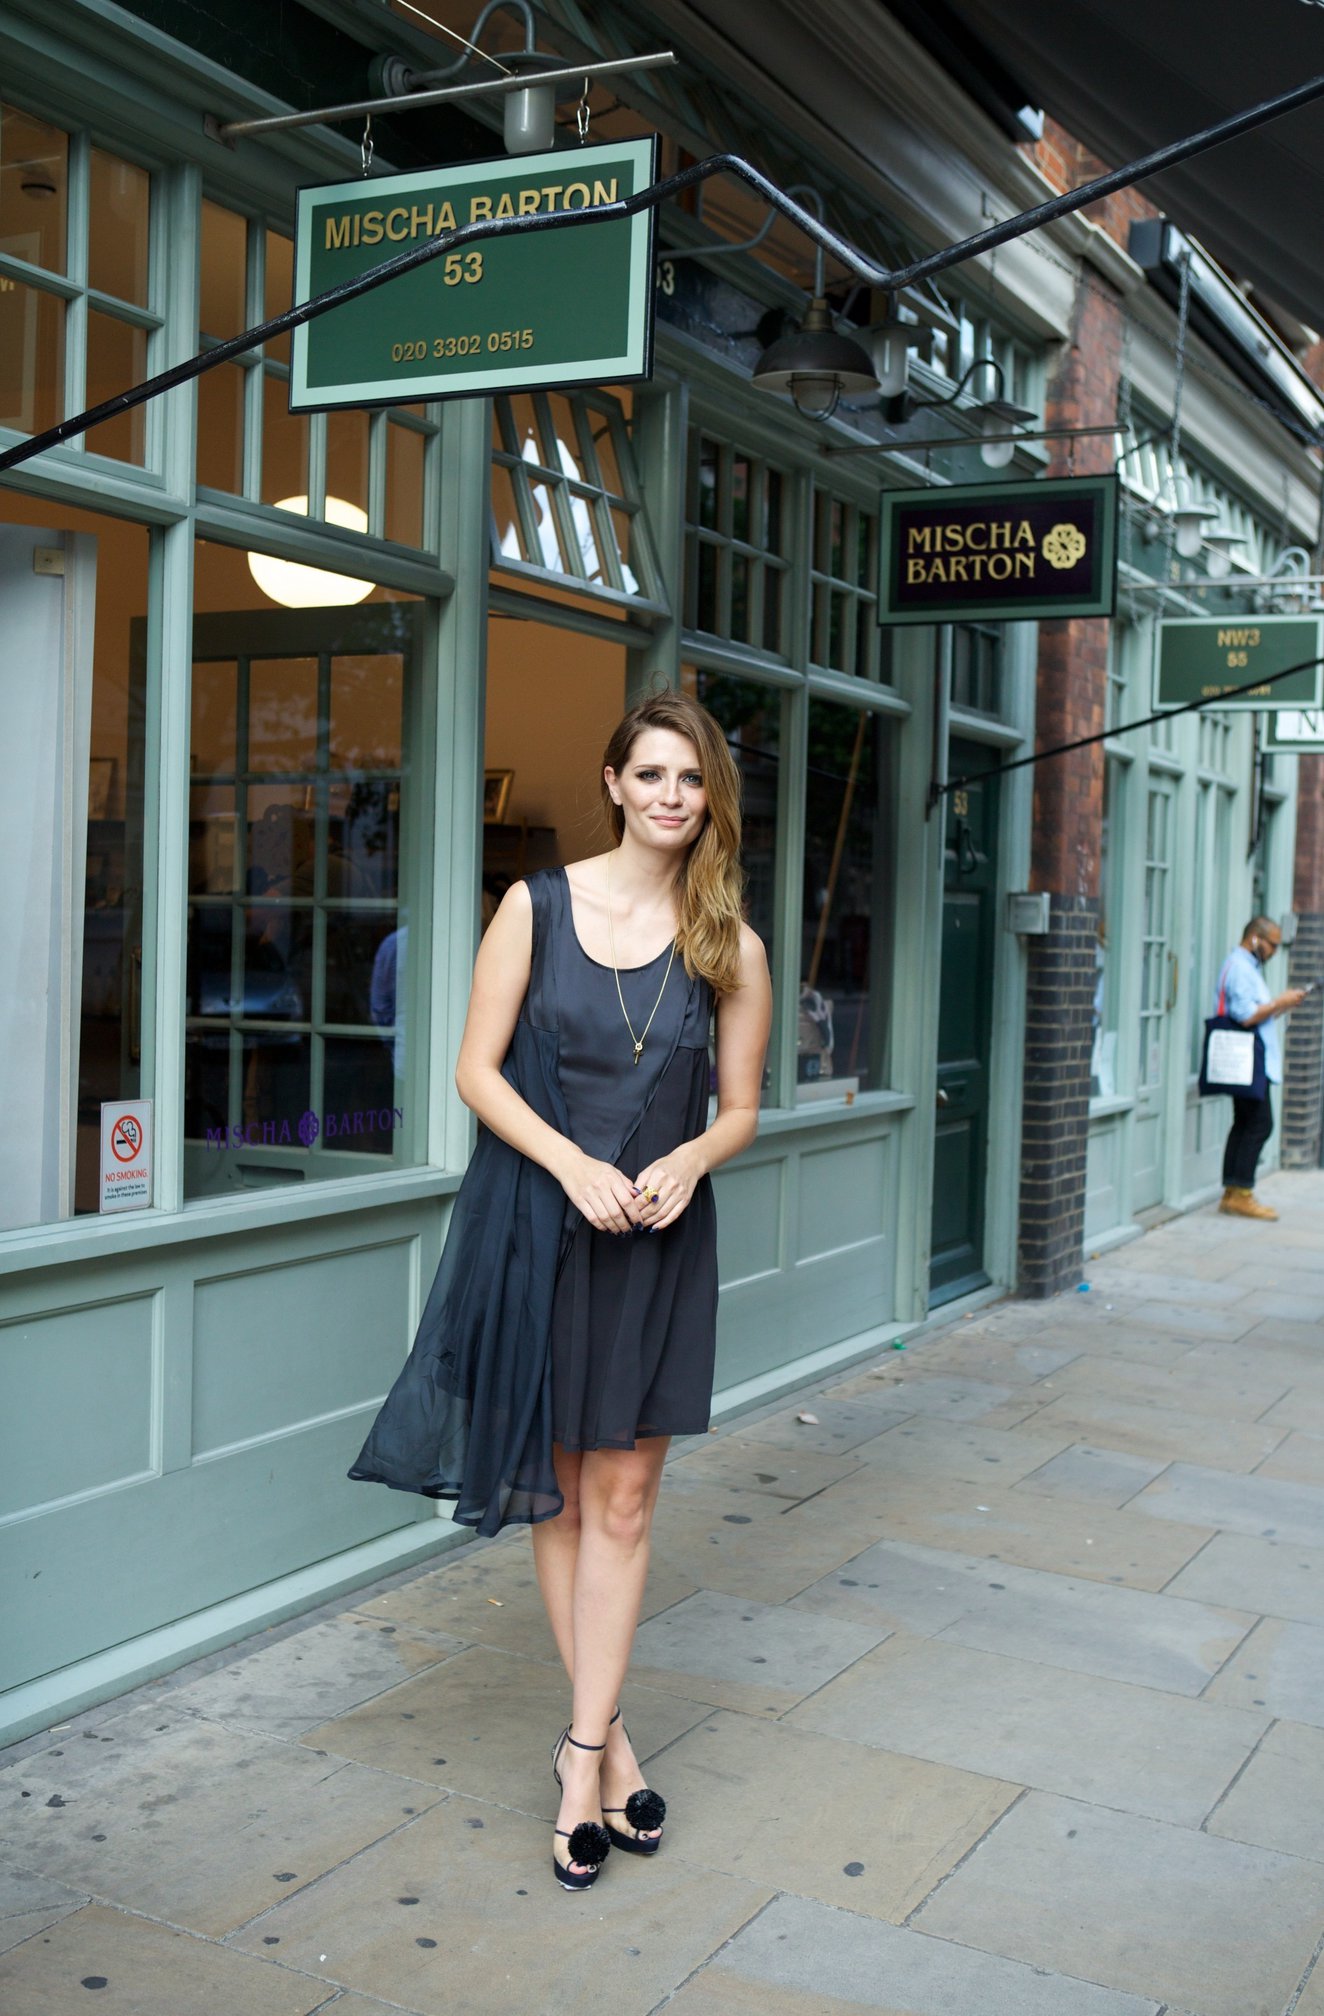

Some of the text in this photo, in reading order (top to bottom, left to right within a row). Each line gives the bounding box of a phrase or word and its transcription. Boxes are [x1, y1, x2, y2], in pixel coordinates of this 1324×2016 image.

[325, 178, 618, 250] MISCHA BARTON
[443, 252, 484, 286] 53
[391, 329, 534, 362] 020 3302 0515
[907, 520, 1036, 554] MISCHA
[907, 552, 1036, 584] BARTON
[1217, 627, 1261, 648] NW3
[206, 1107, 404, 1152] MISCHA BARTON
[105, 1172, 116, 1182] NO
